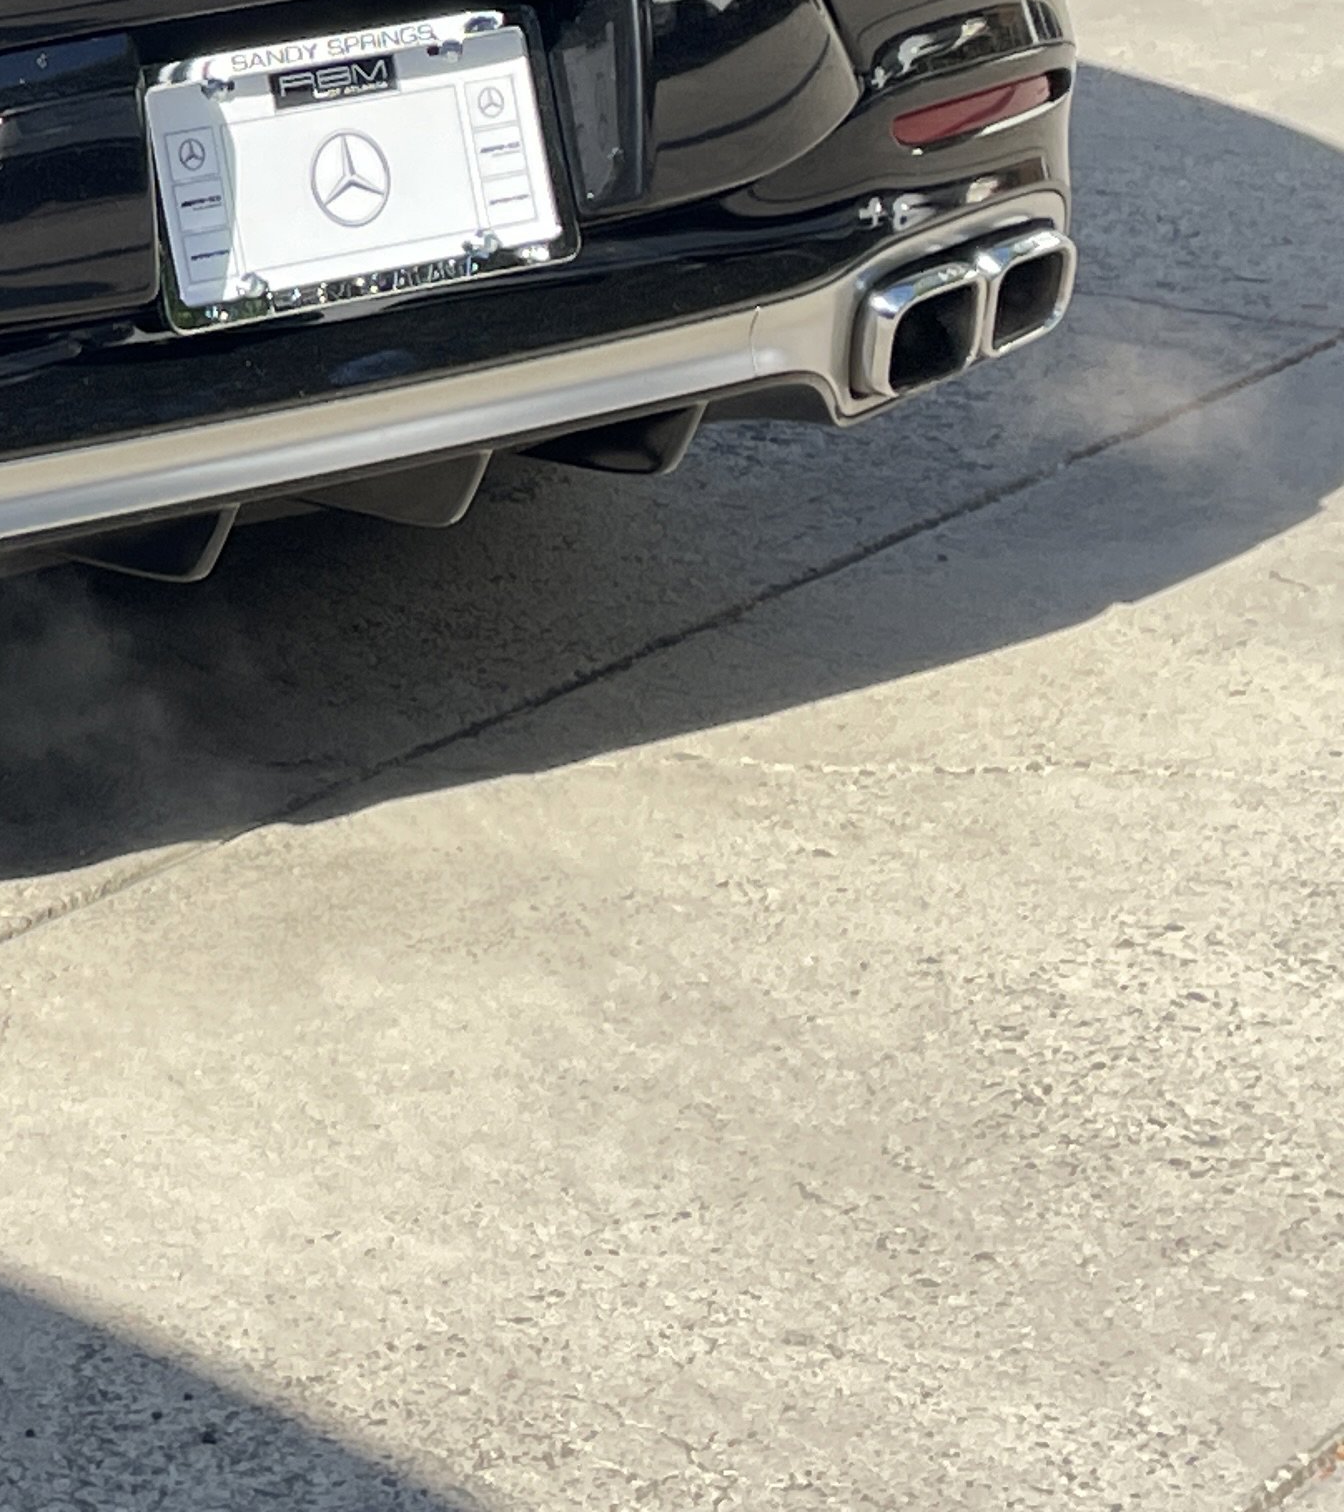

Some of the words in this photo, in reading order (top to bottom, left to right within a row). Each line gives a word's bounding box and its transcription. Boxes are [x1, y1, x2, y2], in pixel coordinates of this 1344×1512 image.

[231, 43, 317, 72] SANDY
[327, 24, 437, 57] SPRINGS
[278, 59, 389, 97] RBM
